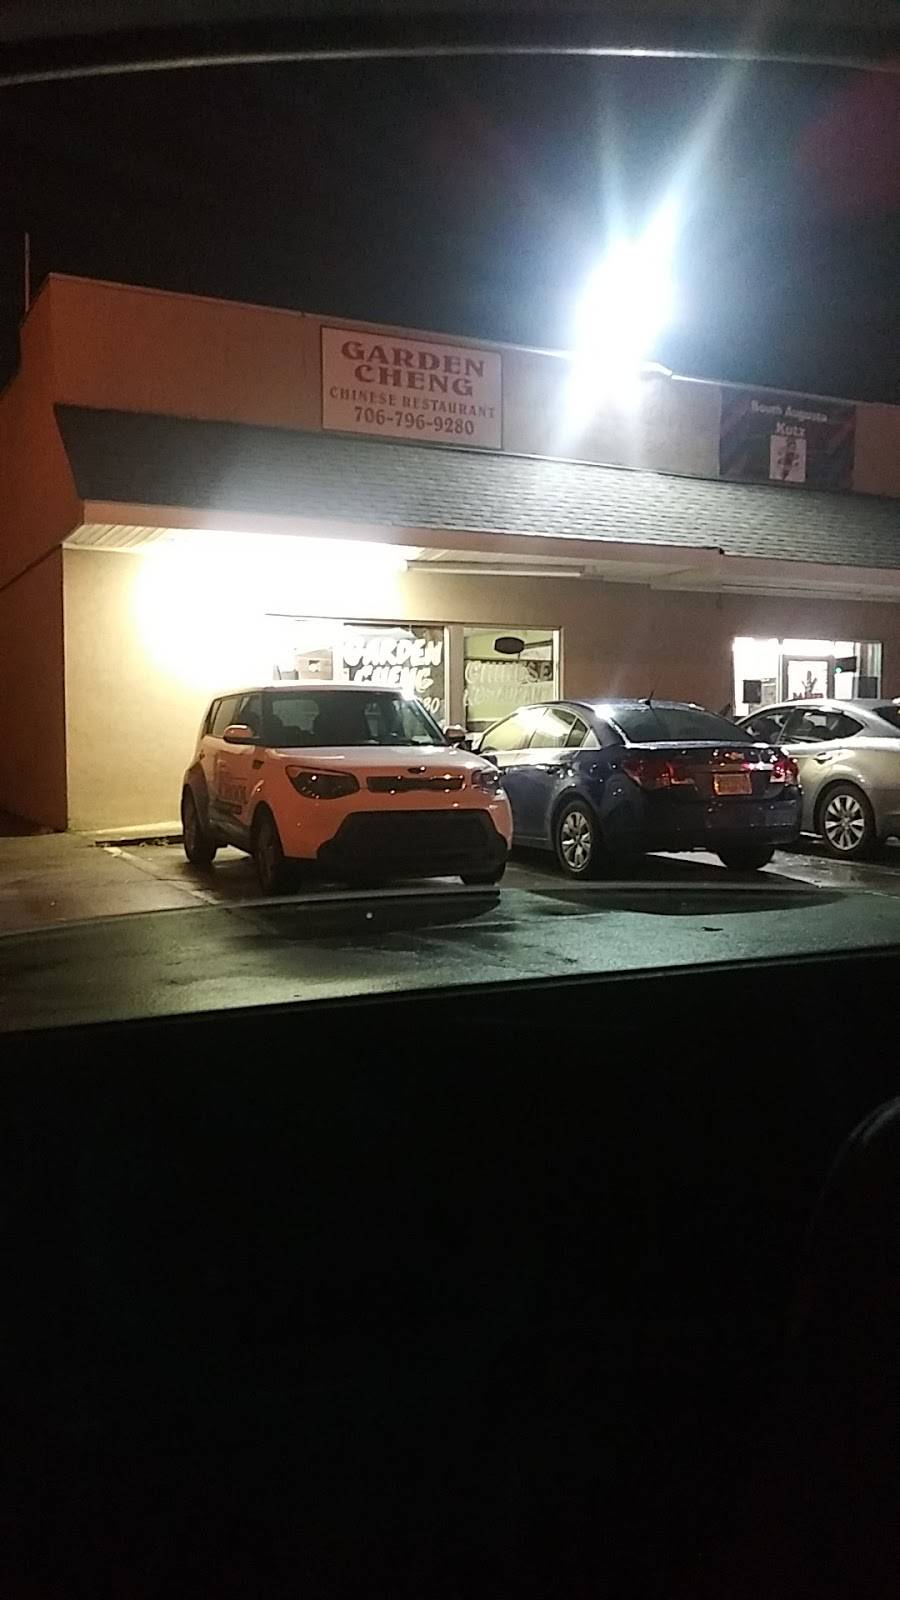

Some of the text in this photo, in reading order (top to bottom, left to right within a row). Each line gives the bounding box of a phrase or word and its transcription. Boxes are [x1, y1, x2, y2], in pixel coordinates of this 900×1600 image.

[342, 341, 485, 377] GARDEN
[354, 364, 473, 397] CHENG
[329, 386, 496, 418] CHINESE RESTAURANT
[354, 406, 474, 435] 706-796-9280
